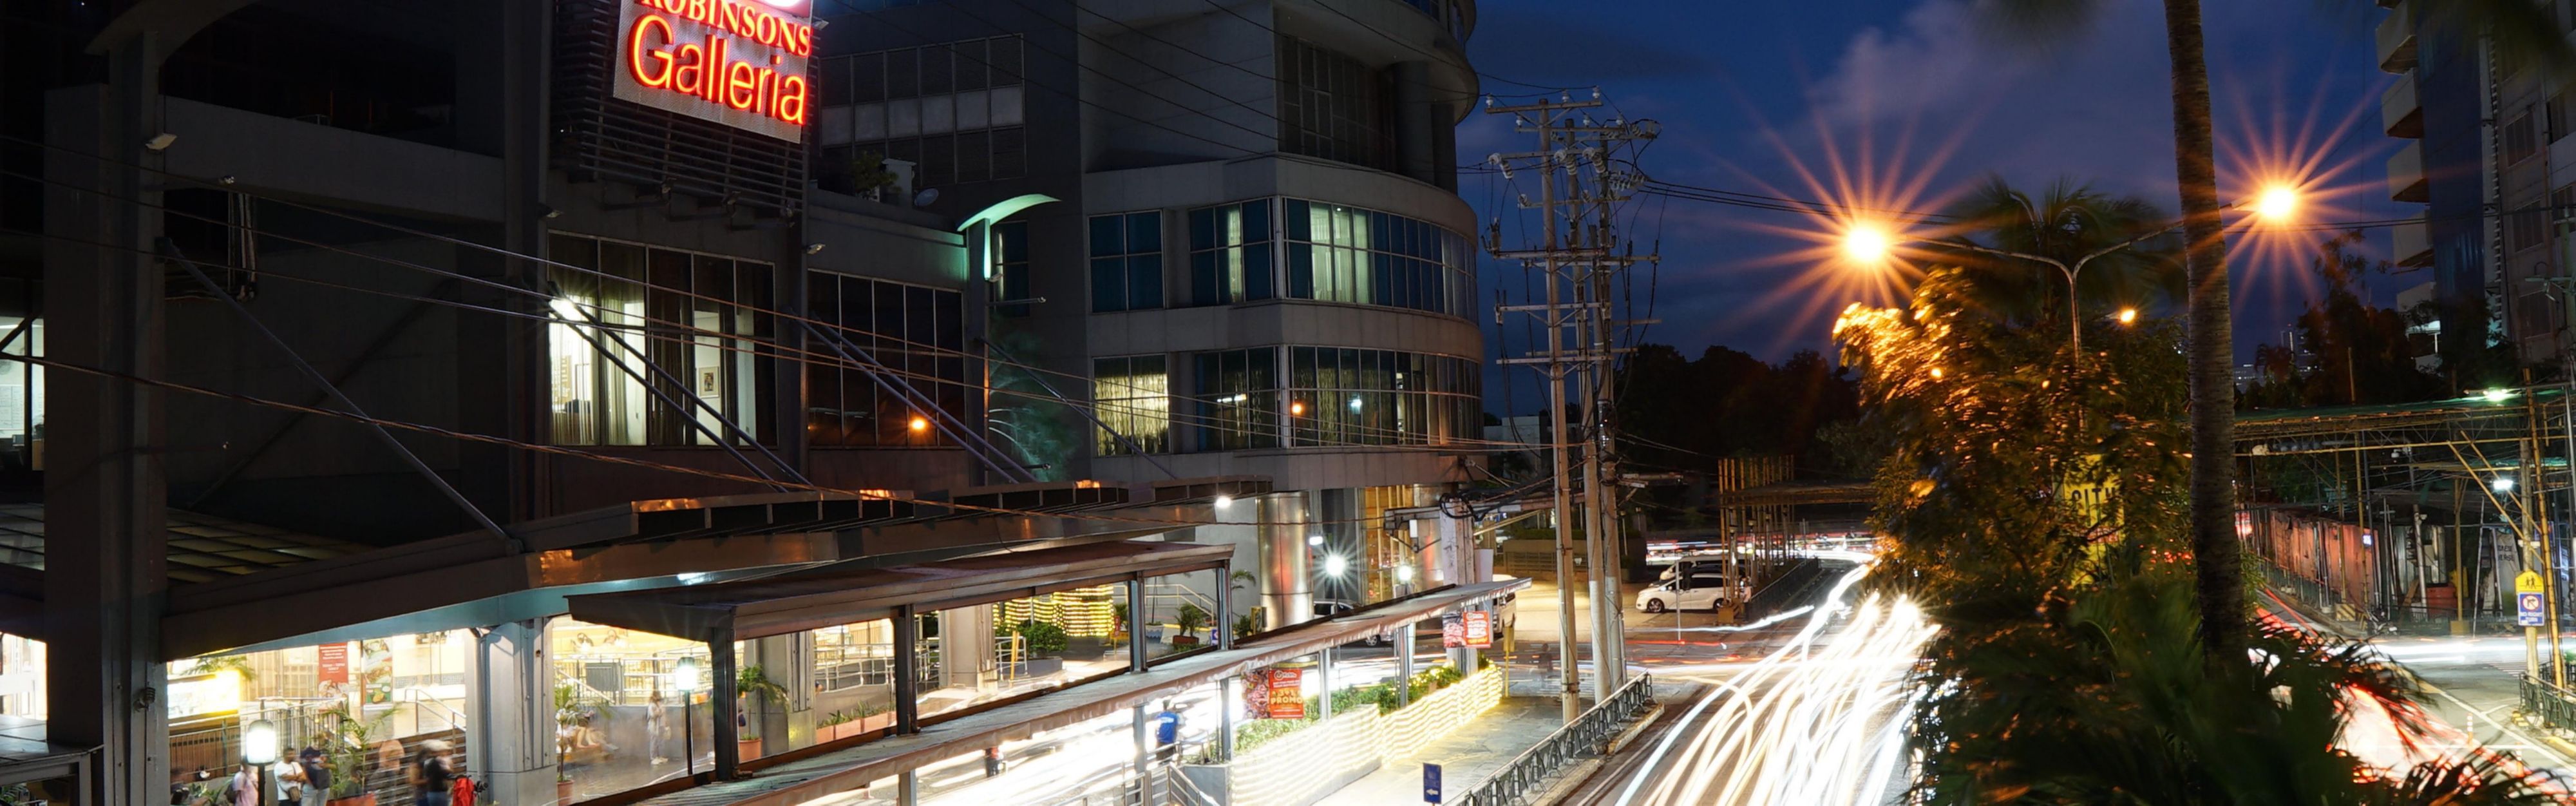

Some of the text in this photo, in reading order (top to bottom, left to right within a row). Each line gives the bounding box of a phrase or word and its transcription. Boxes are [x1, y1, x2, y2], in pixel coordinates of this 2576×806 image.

[639, 0, 812, 57] BINSONS
[628, 14, 808, 125] Galleria
[1271, 696, 1303, 705] PROMO
